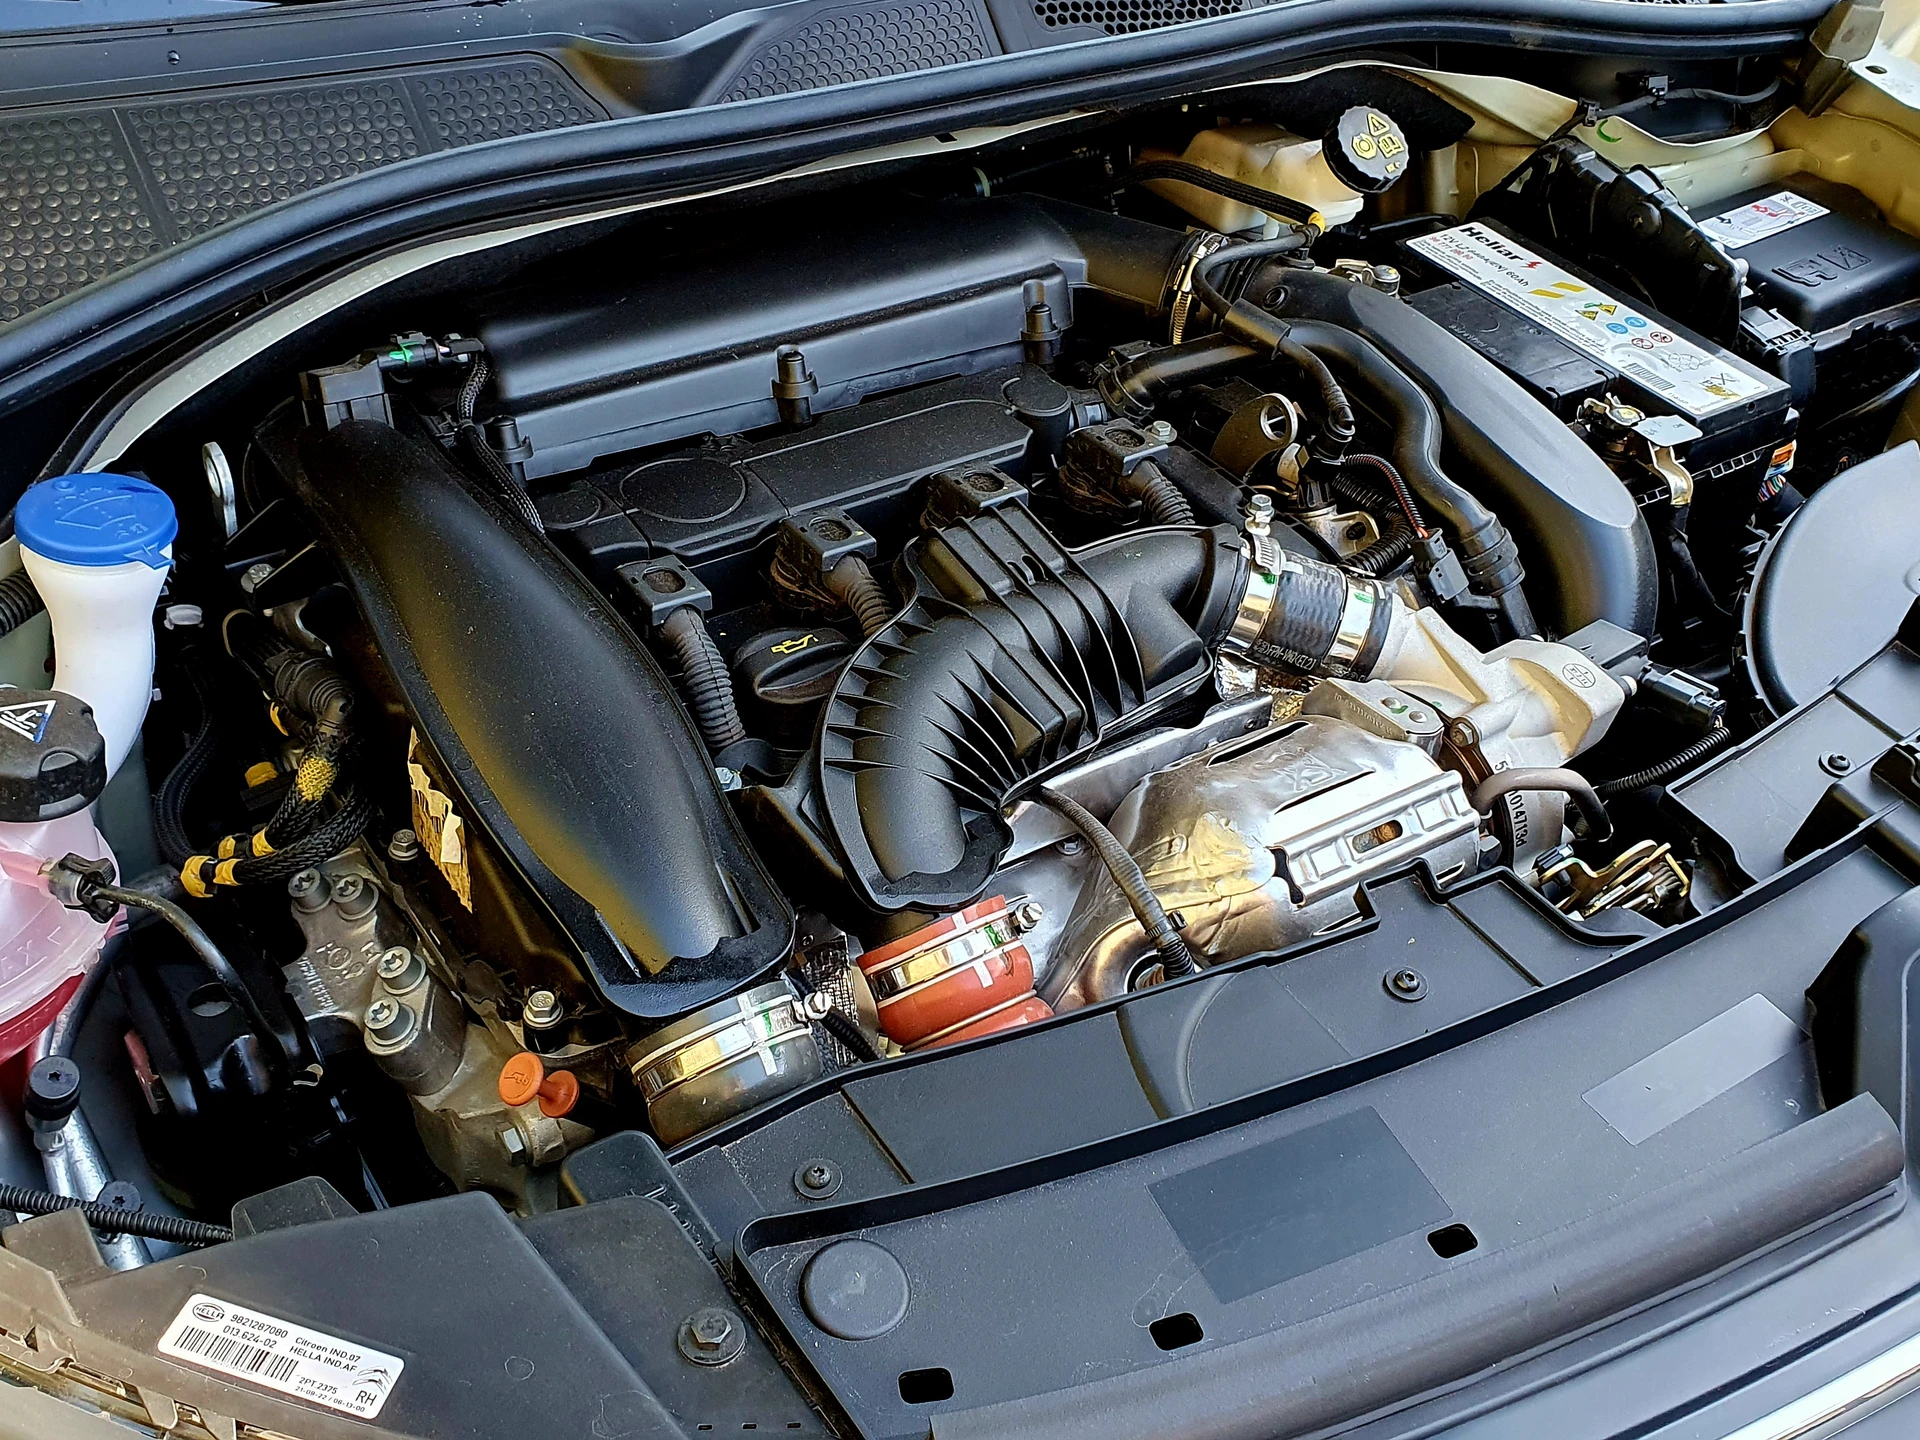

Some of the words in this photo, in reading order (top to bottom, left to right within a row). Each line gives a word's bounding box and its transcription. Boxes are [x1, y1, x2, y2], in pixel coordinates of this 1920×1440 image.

[1440, 233, 1459, 243] 12V
[1459, 226, 1525, 261] Heliar
[195, 1306, 225, 1320] HELLA
[222, 1324, 278, 1349] 013.624-02
[230, 1314, 289, 1339] 9821287080
[289, 1346, 322, 1363] HELLA
[323, 1357, 359, 1373] IND.AF
[329, 1346, 361, 1363] IND.07
[355, 1389, 378, 1407] RH
